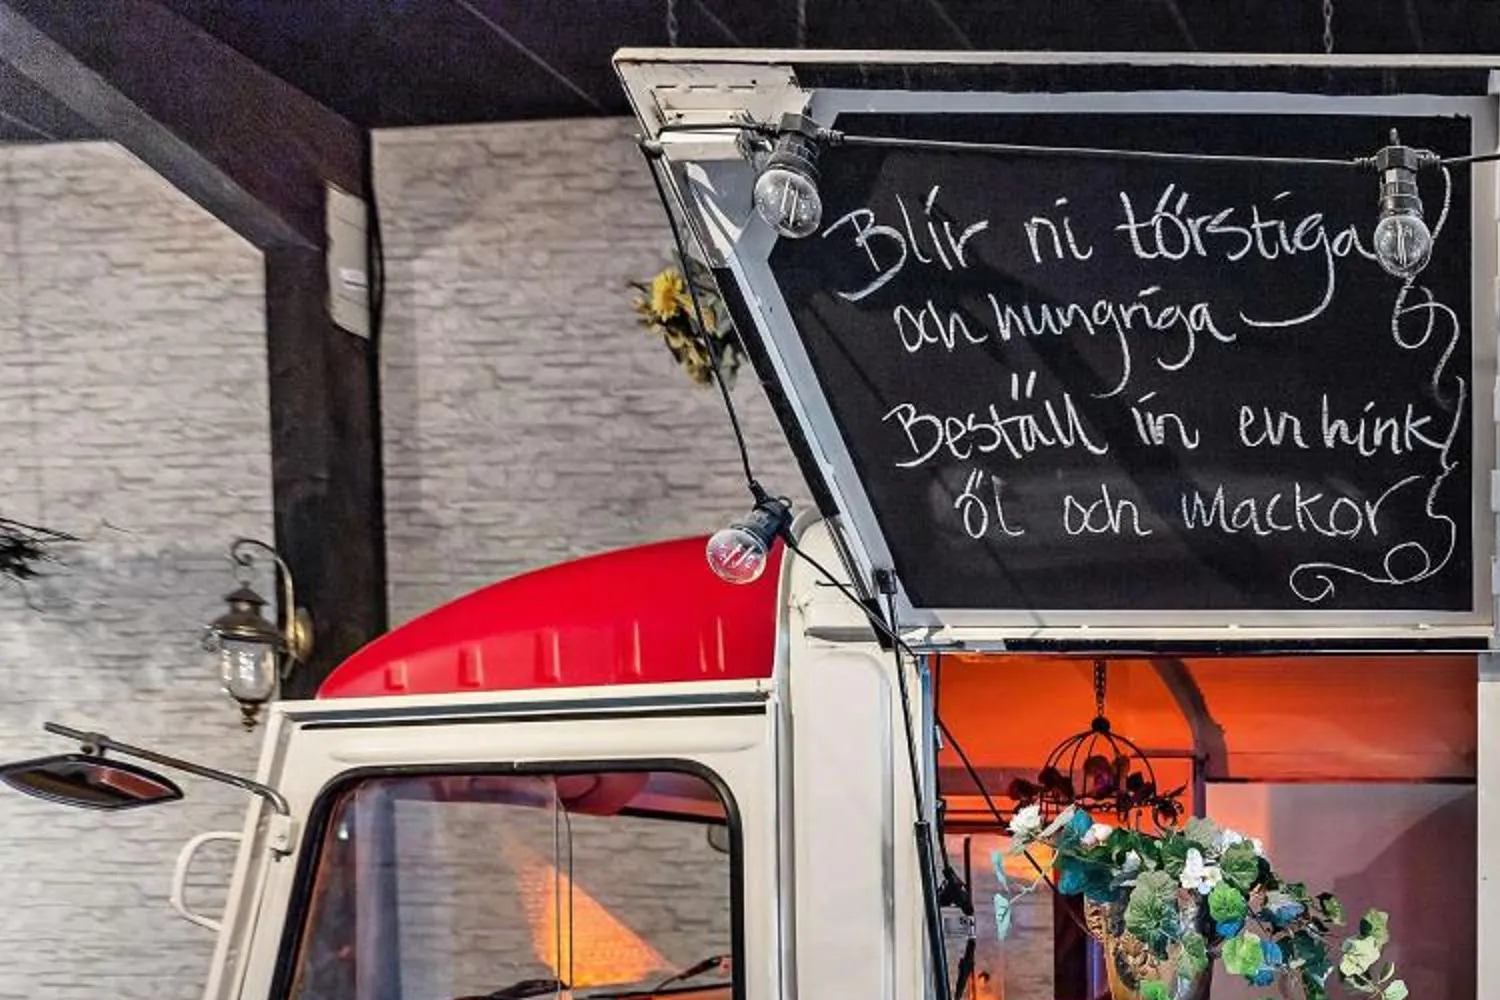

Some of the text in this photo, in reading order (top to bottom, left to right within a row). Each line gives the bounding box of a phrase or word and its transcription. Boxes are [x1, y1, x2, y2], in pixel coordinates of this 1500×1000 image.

[822, 183, 1376, 327] Blir ni törstiga
[893, 286, 1237, 398] och hungriga
[882, 371, 1446, 467] Beställ in en hink
[1062, 483, 1152, 536] och
